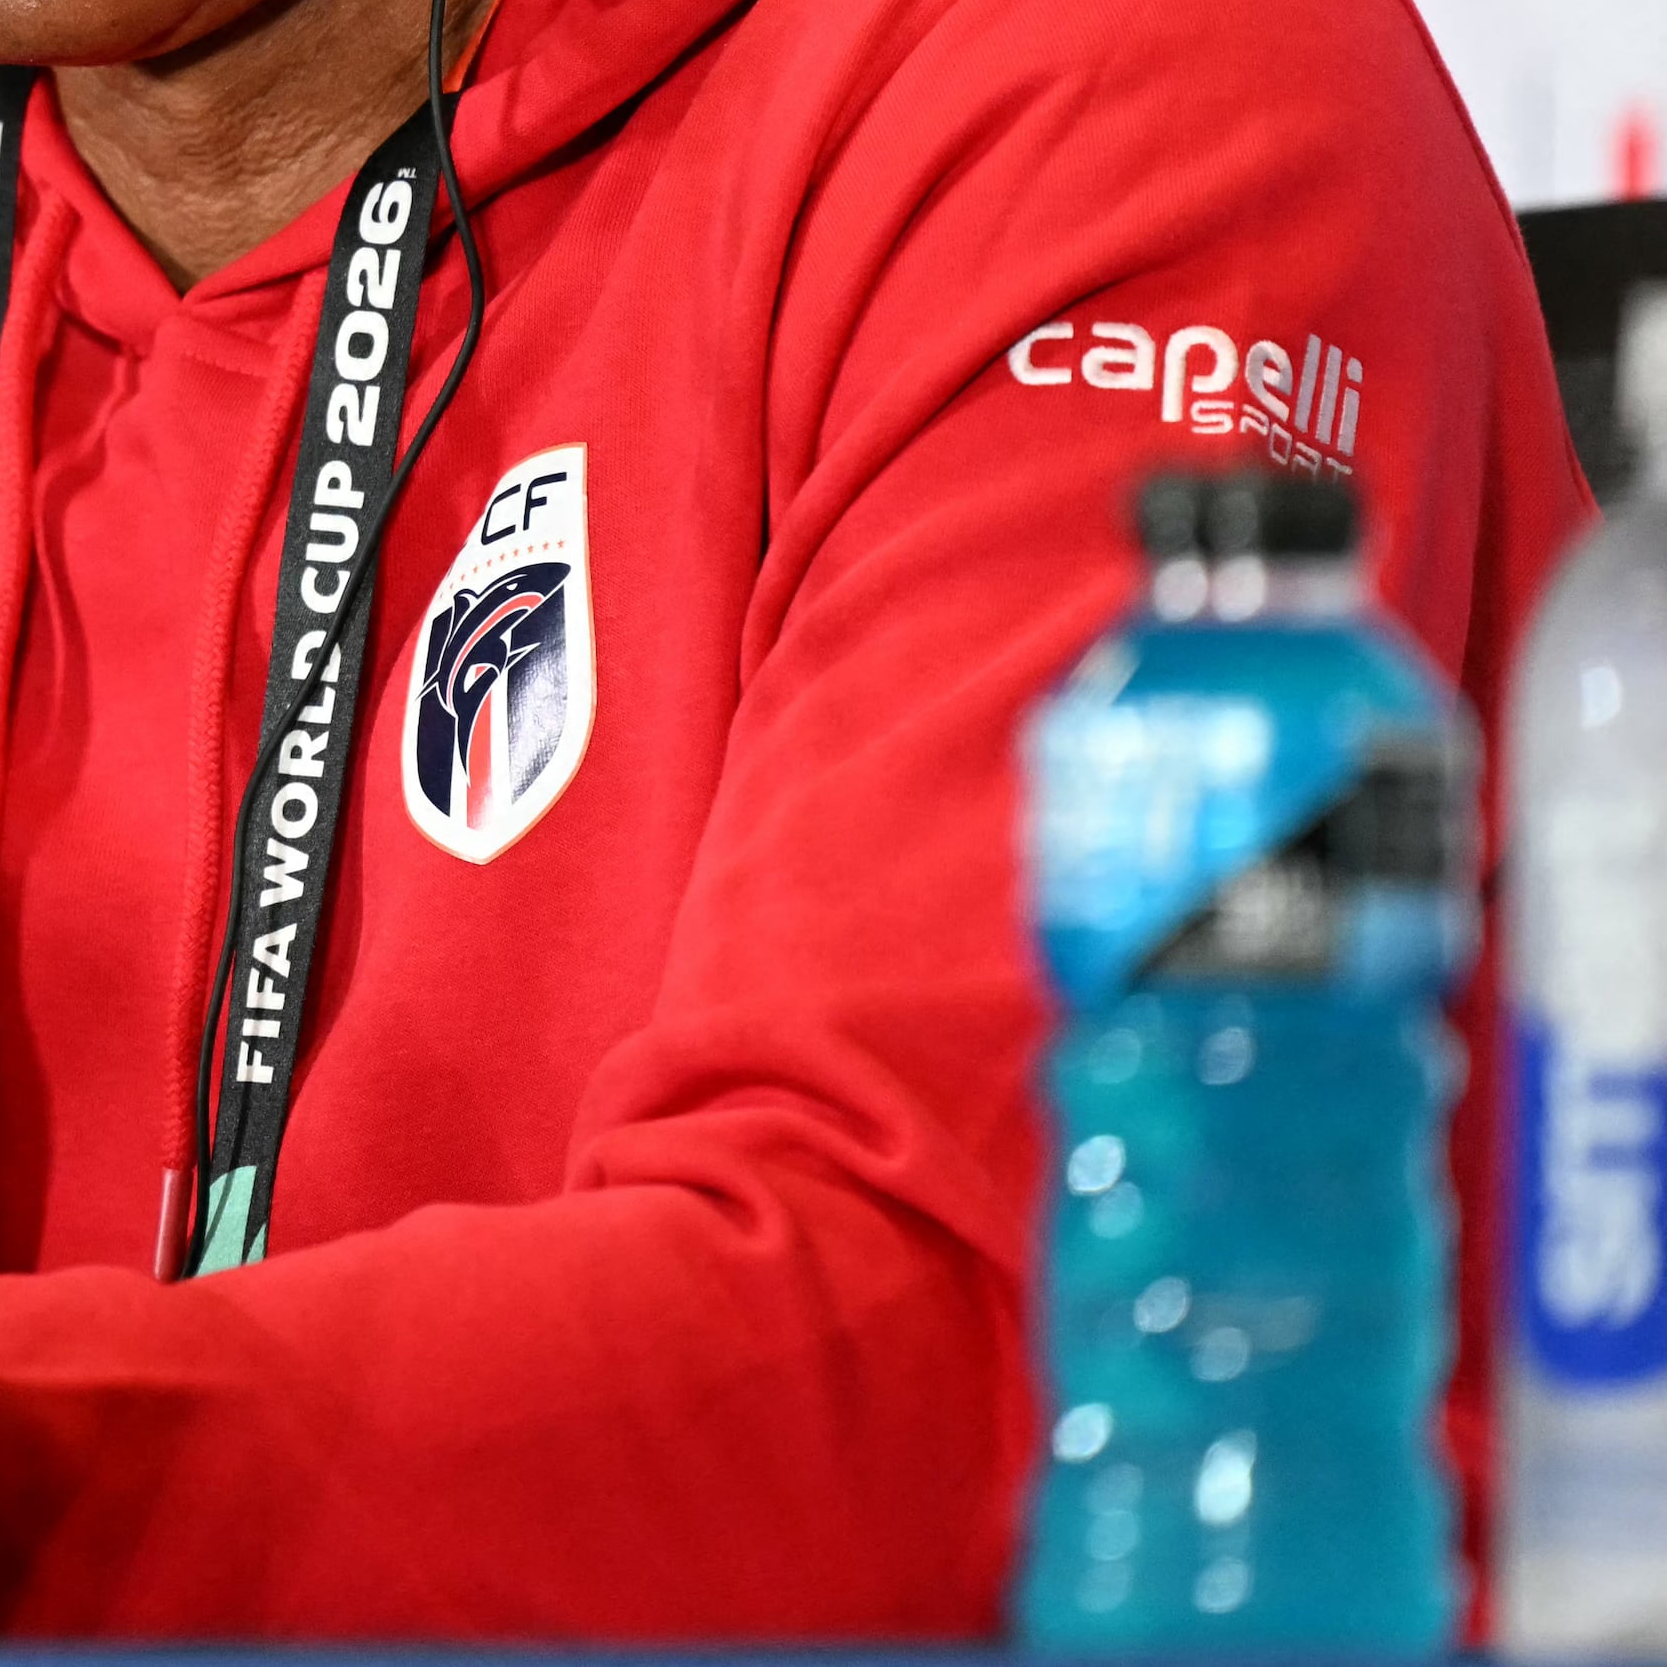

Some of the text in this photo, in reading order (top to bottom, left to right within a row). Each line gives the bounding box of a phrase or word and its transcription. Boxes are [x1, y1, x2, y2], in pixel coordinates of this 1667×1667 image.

[1007, 320, 1364, 458] capelli
[1190, 400, 1354, 482] SPORT
[300, 460, 365, 614] CUP
[260, 630, 342, 908] WORLD
[236, 923, 297, 1084] FIFA
